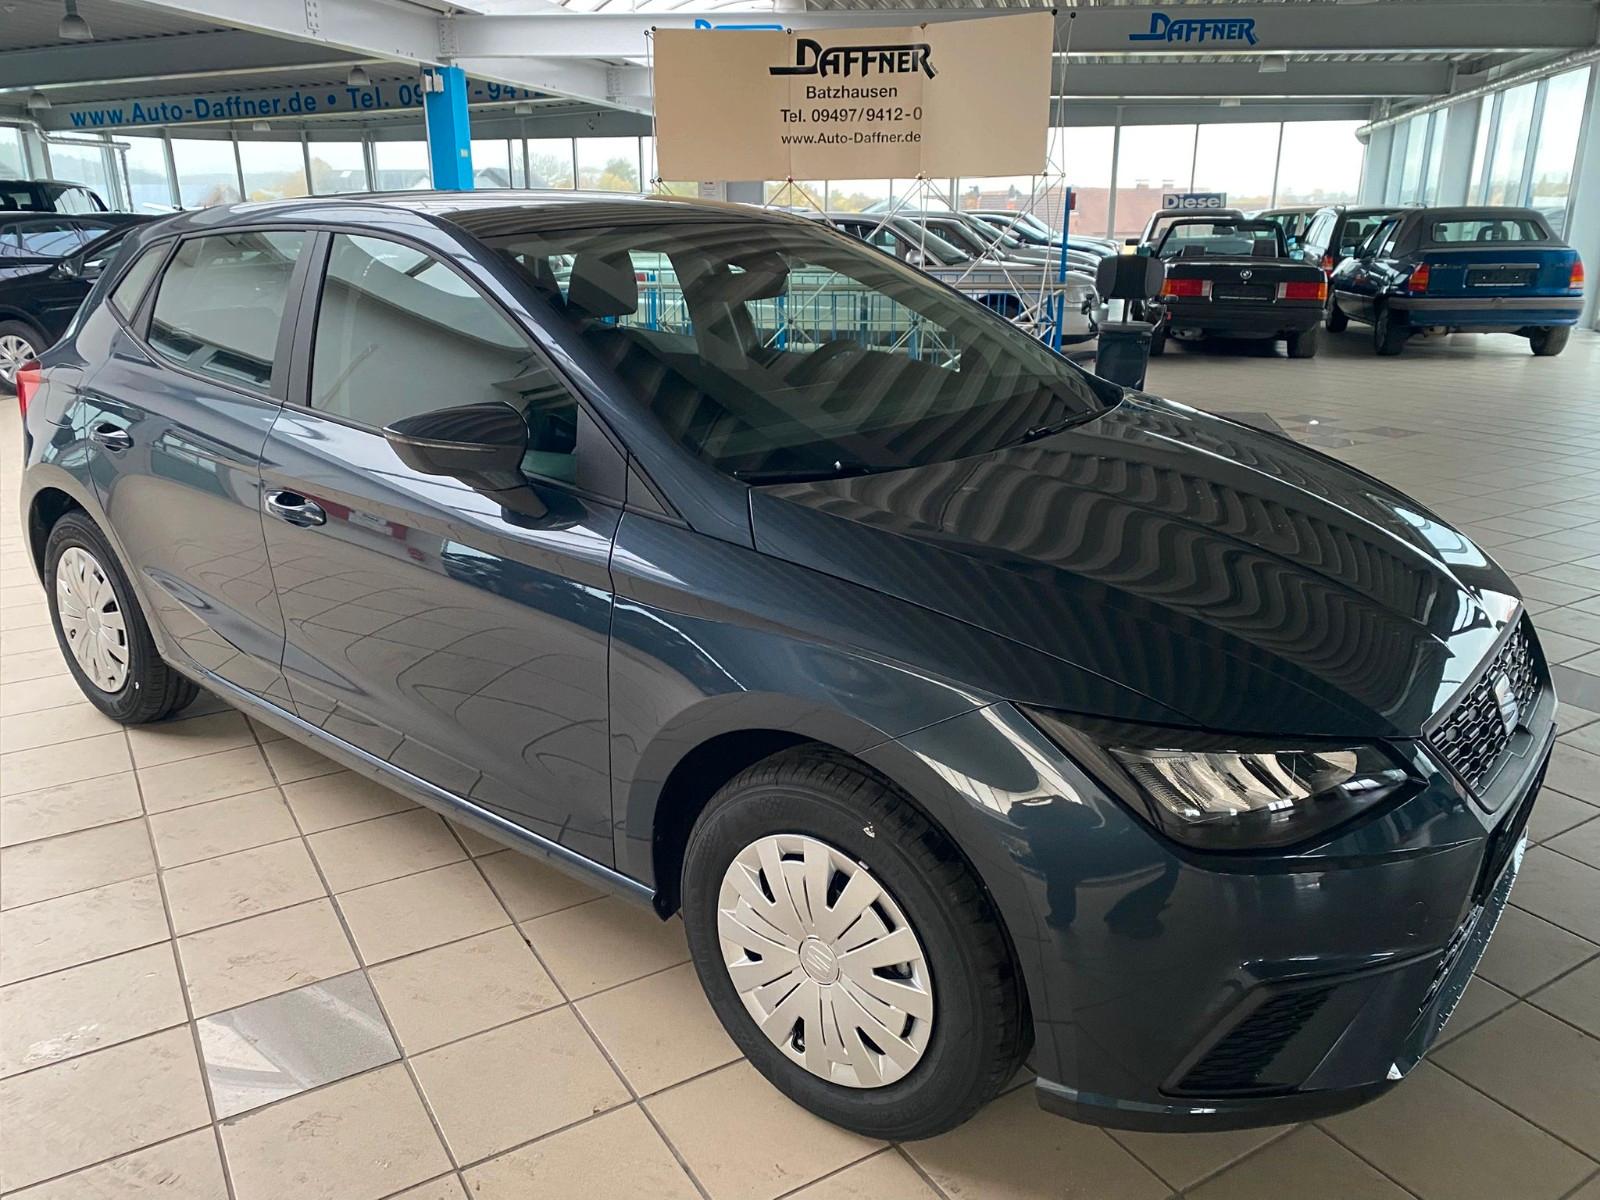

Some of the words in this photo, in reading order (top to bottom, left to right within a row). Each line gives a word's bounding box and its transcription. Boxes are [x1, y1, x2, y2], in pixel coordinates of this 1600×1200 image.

[1129, 12, 1257, 45] DAFFNER
[769, 39, 936, 79] DAFFNER
[806, 85, 898, 99] Batzhausen
[70, 92, 317, 126] www.Auto-Daffner.de
[346, 86, 390, 109] Tel.
[780, 109, 806, 122] Tel.
[811, 107, 923, 122] 09497/9412-0
[781, 131, 921, 144] www.Auto-Daffner.de
[1163, 193, 1226, 208] Diesel
